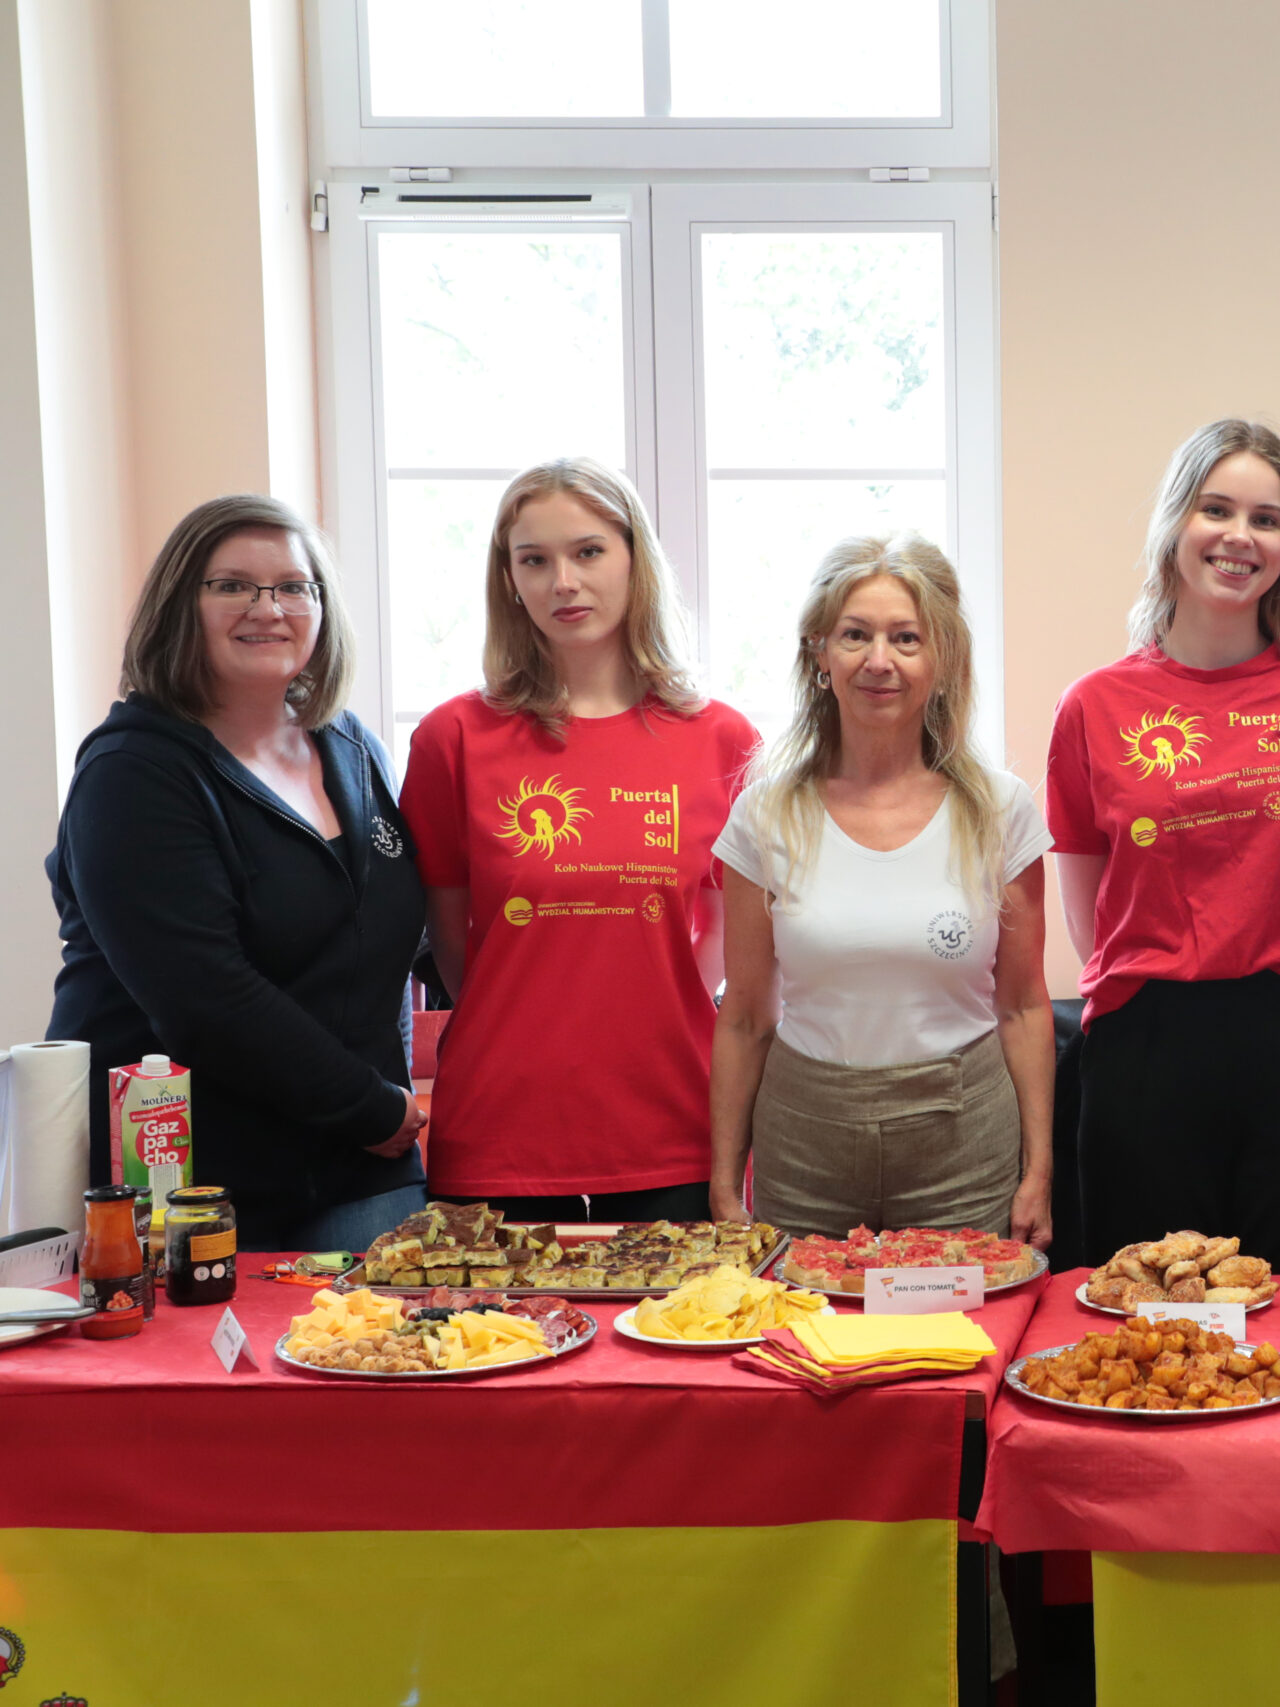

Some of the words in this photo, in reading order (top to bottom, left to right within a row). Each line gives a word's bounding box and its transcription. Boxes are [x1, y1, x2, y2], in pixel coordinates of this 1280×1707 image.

[1175, 781, 1198, 791] Koło
[1199, 770, 1240, 786] Naukowe
[1236, 779, 1265, 789] Puerta
[1267, 774, 1280, 784] del
[610, 787, 671, 803] Puerta
[644, 810, 671, 825] del
[1197, 809, 1257, 826] HUMANISTYCZNY
[644, 831, 672, 848] Sol
[554, 864, 578, 873] Koło
[580, 863, 624, 873] Naukowe
[626, 862, 678, 875] Hispanistów
[619, 875, 648, 885] Puerta
[650, 876, 663, 885] del
[664, 876, 678, 887] Sol
[572, 907, 636, 916] HUMANISTYCZNY
[143, 1120, 180, 1136] Gaz
[143, 1135, 168, 1154] pa
[143, 1148, 179, 1167] cho
[910, 1284, 926, 1292] CON
[928, 1283, 956, 1291] TOMATE
